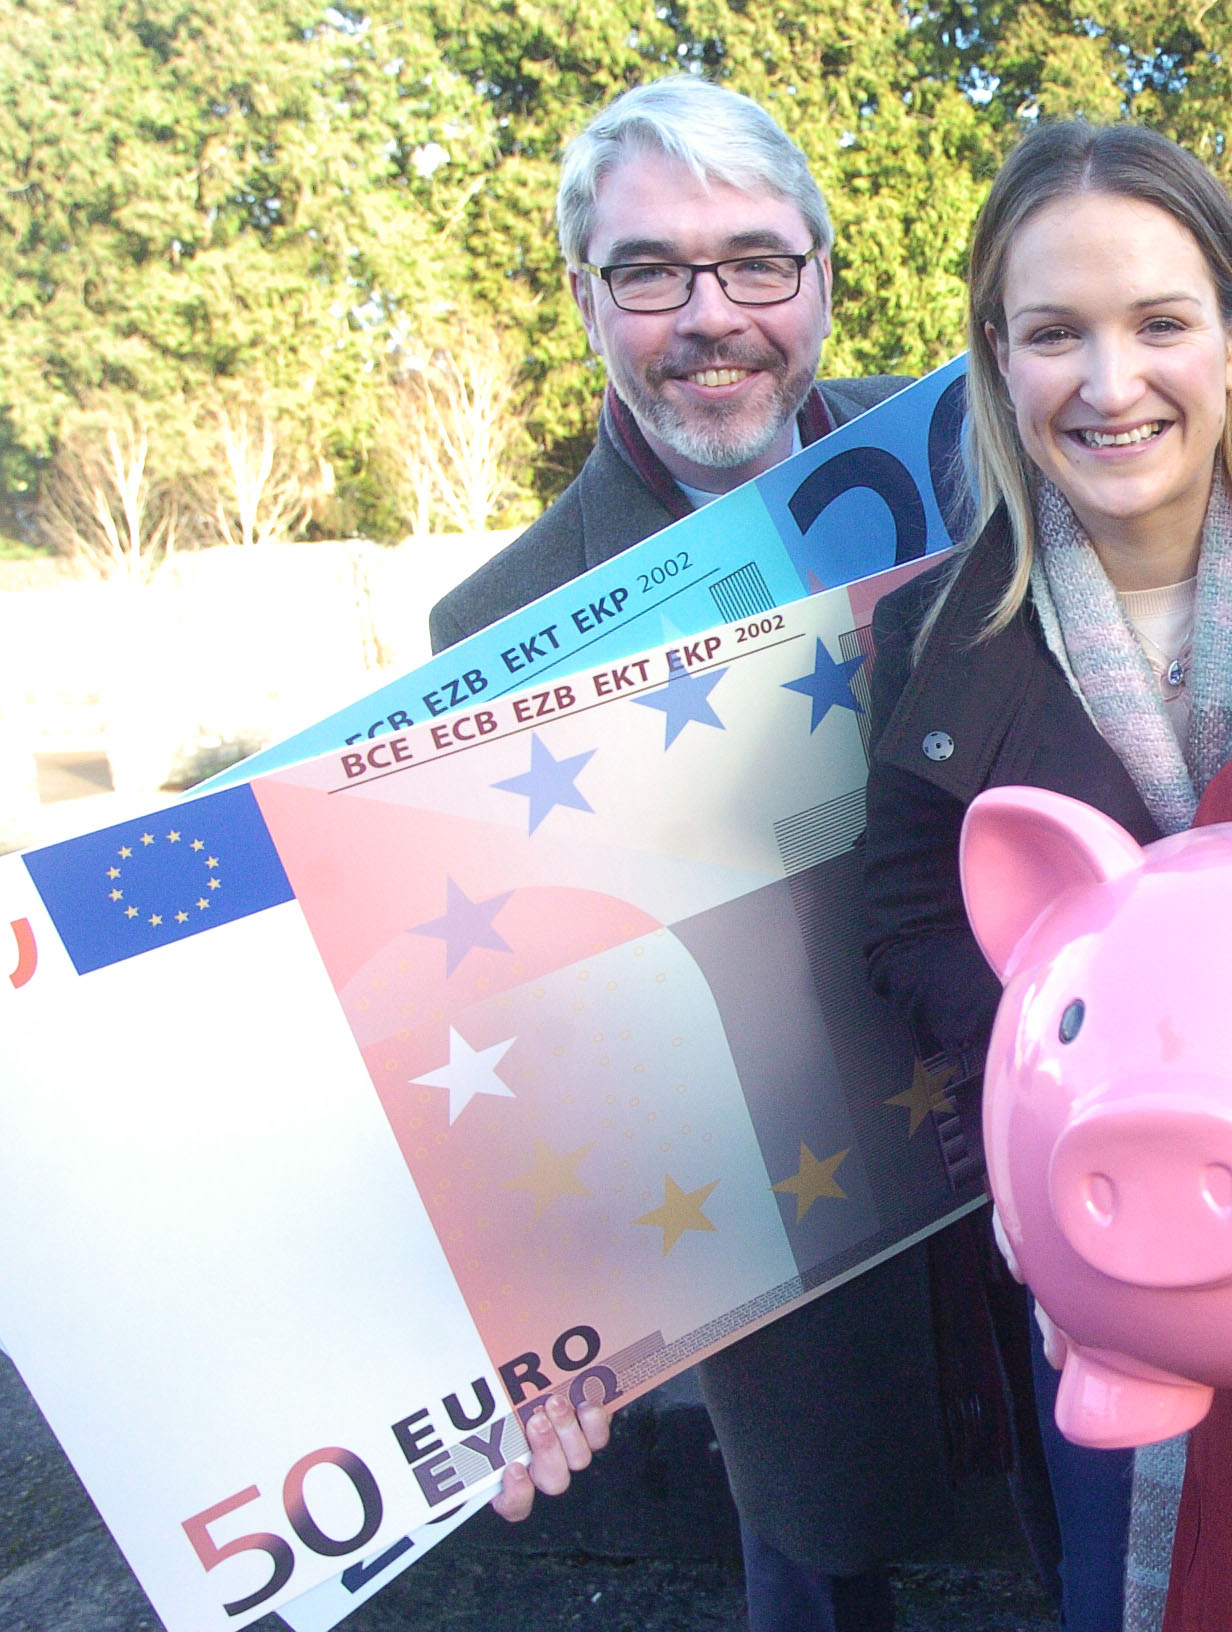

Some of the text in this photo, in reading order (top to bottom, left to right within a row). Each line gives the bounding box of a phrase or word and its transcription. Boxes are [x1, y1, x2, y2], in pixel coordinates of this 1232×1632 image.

[340, 614, 787, 779] BCE ECB EZB EKT EKP 2002
[422, 669, 488, 717] EZB
[500, 624, 560, 674] EKT
[570, 587, 630, 635] EKP
[636, 550, 694, 595] 2002
[180, 1445, 384, 1617] 50
[391, 1325, 601, 1465] EURO
